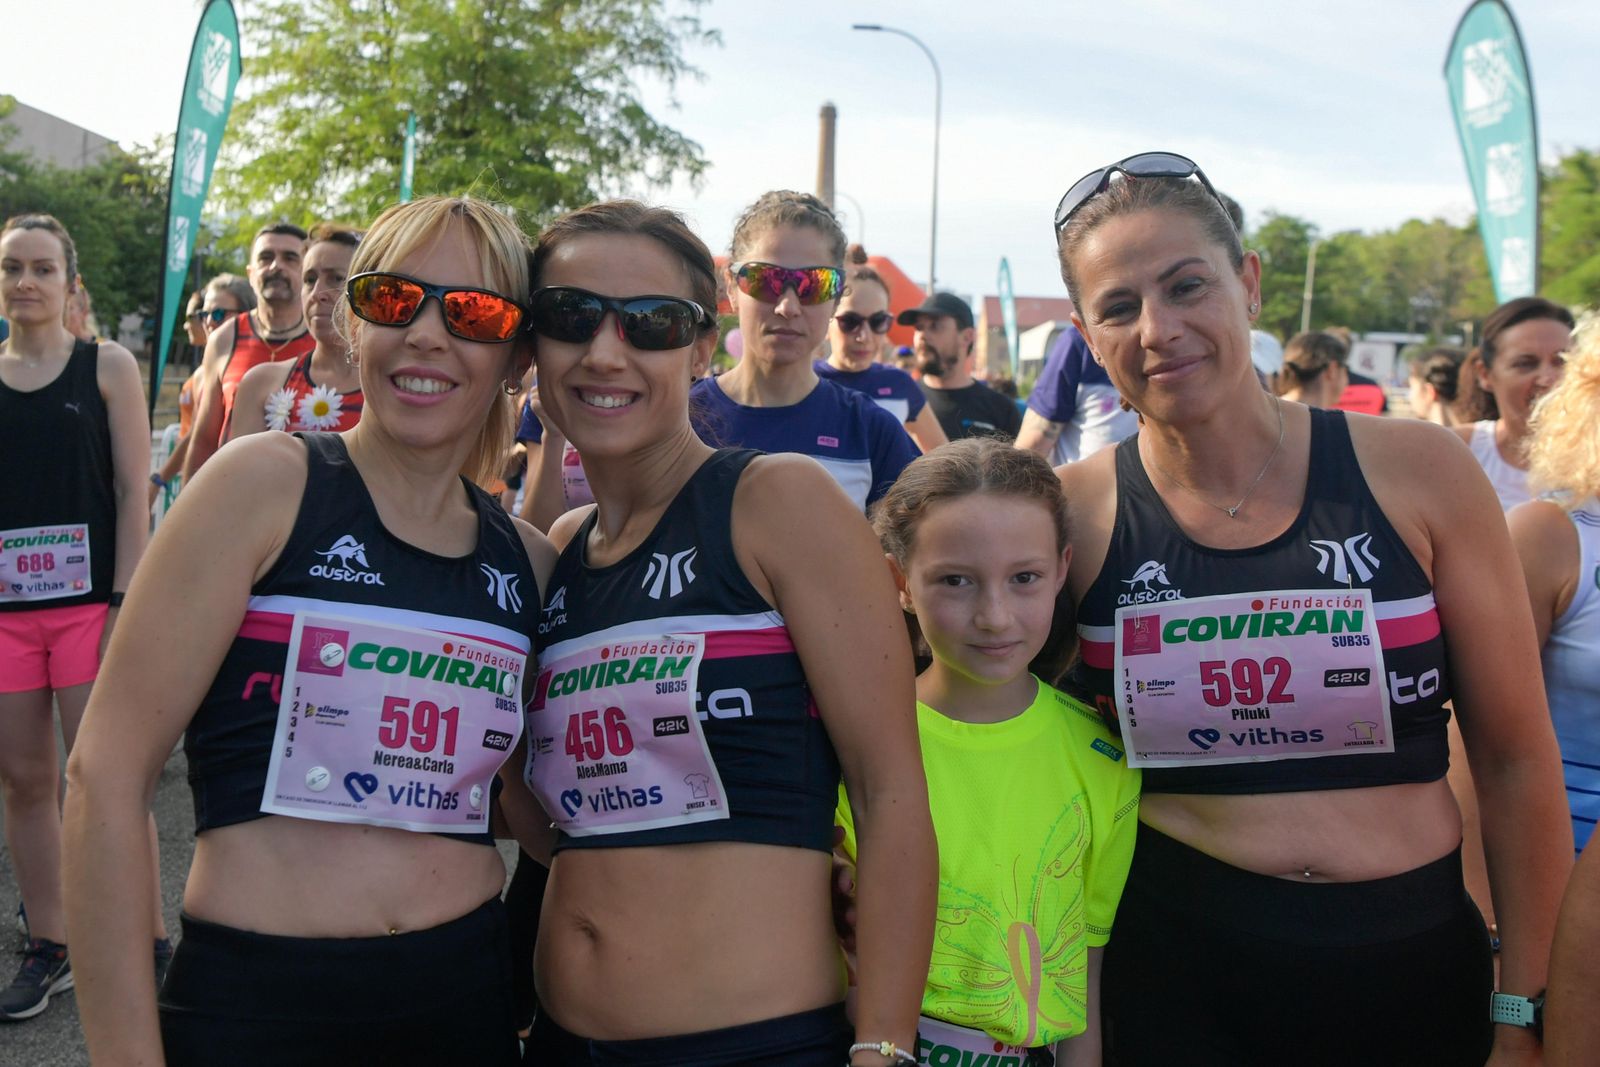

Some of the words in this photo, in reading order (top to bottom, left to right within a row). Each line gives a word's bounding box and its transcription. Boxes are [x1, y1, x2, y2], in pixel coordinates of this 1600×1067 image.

[17, 552, 55, 574] 688
[27, 582, 65, 592] vithas
[1269, 596, 1363, 611] Fundación
[1162, 609, 1364, 644] COVIRAN
[1331, 634, 1371, 648] SUB35
[612, 641, 695, 658] Fundación
[457, 645, 520, 673] Fundación
[547, 655, 694, 699] COVIRAN
[1124, 667, 1129, 677] 1
[1327, 671, 1366, 683] 42K
[655, 680, 688, 695] SUB35
[1125, 680, 1131, 691] 2
[1147, 679, 1176, 687] olimpo
[1199, 656, 1295, 707] 592
[296, 686, 301, 697] 1
[1126, 693, 1132, 704] 3
[292, 701, 299, 712] 2
[317, 705, 349, 717] olimpo
[495, 697, 518, 714] SUB35
[1128, 706, 1135, 716] 4
[1231, 707, 1270, 721] Piluki
[290, 716, 297, 727] 3
[378, 695, 460, 756] 591
[655, 718, 687, 732] 42K
[1130, 718, 1137, 728] 5
[287, 731, 294, 743] 4
[484, 732, 511, 749] 42K
[564, 706, 634, 762] 456
[1229, 727, 1324, 746] vithas
[285, 746, 293, 758] 5
[373, 750, 455, 774] Nerea&Carla
[576, 761, 628, 780] Ale&Mama
[388, 781, 460, 810] vithas
[587, 785, 664, 813] vithas
